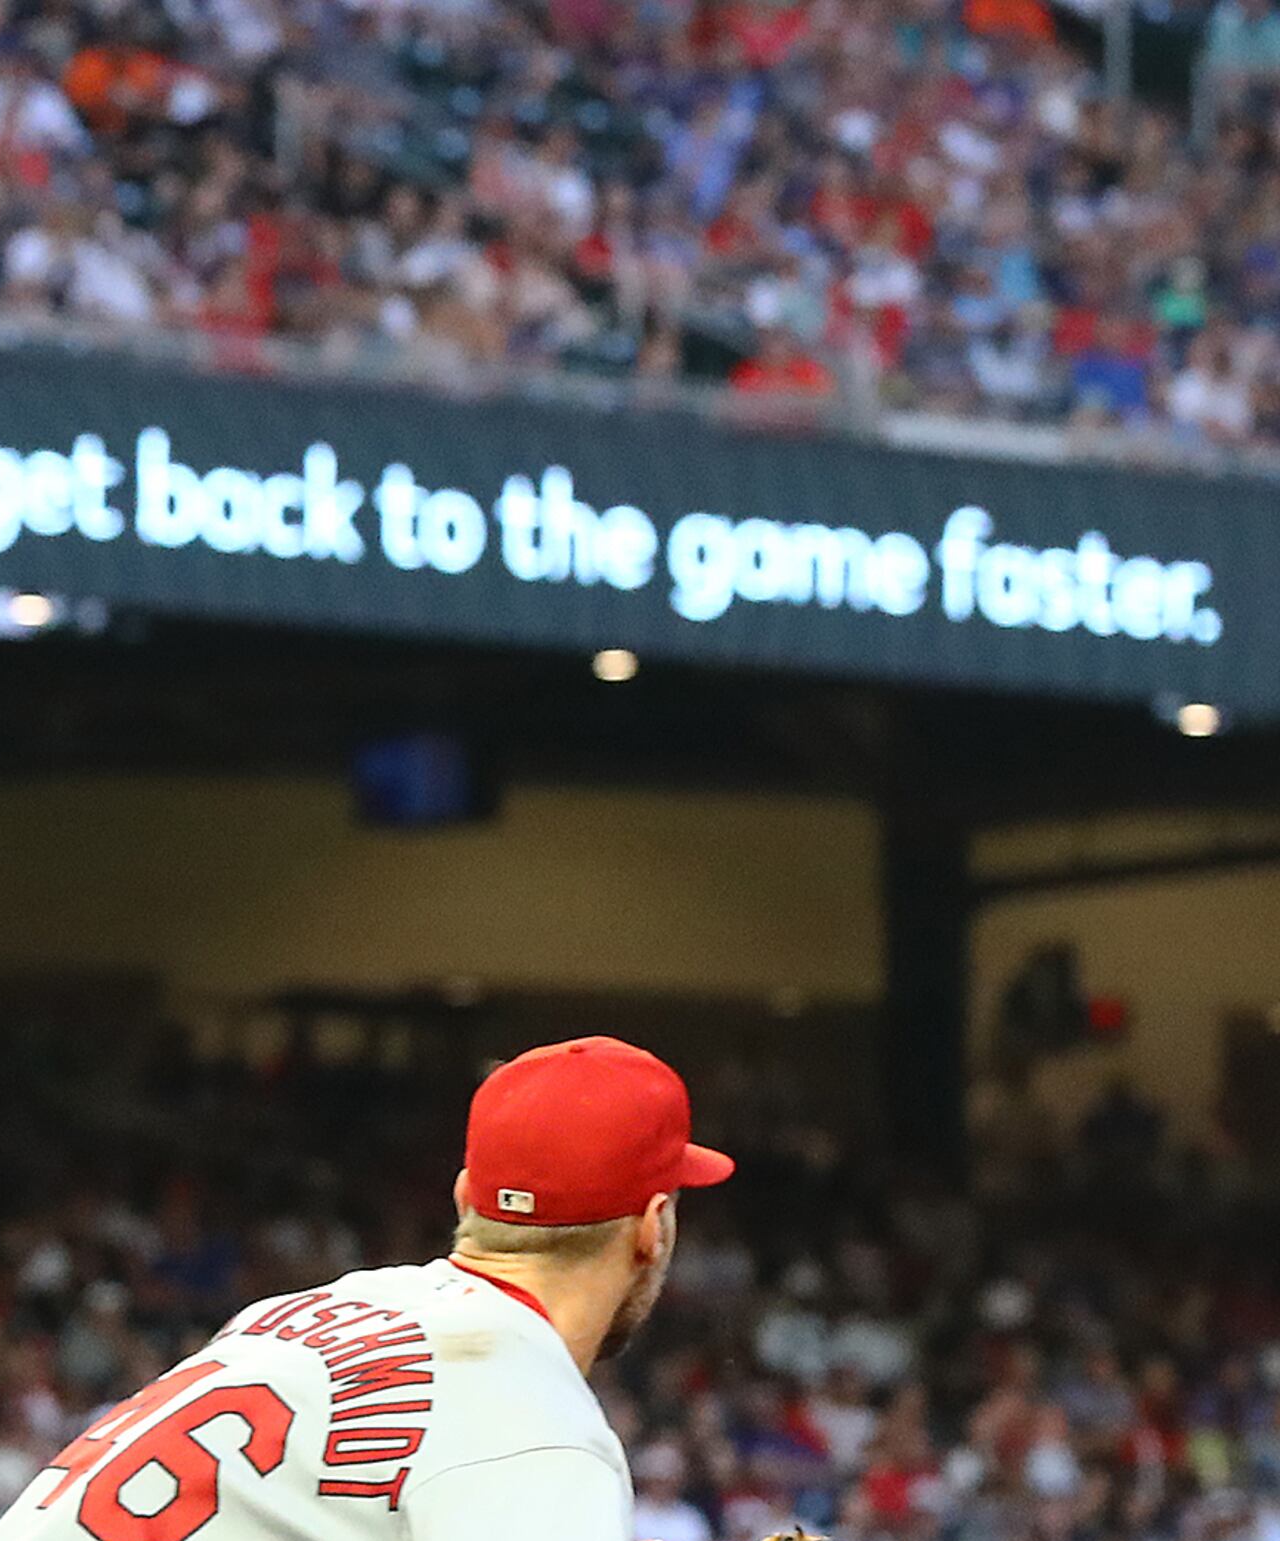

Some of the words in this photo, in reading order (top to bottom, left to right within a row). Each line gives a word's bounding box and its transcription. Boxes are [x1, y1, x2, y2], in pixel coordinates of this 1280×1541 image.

[135, 427, 365, 562] back
[377, 464, 487, 574] to
[498, 466, 658, 591] the
[668, 510, 930, 622] game
[939, 506, 1224, 646] faster.
[212, 1293, 434, 1511] DSCHMIDT
